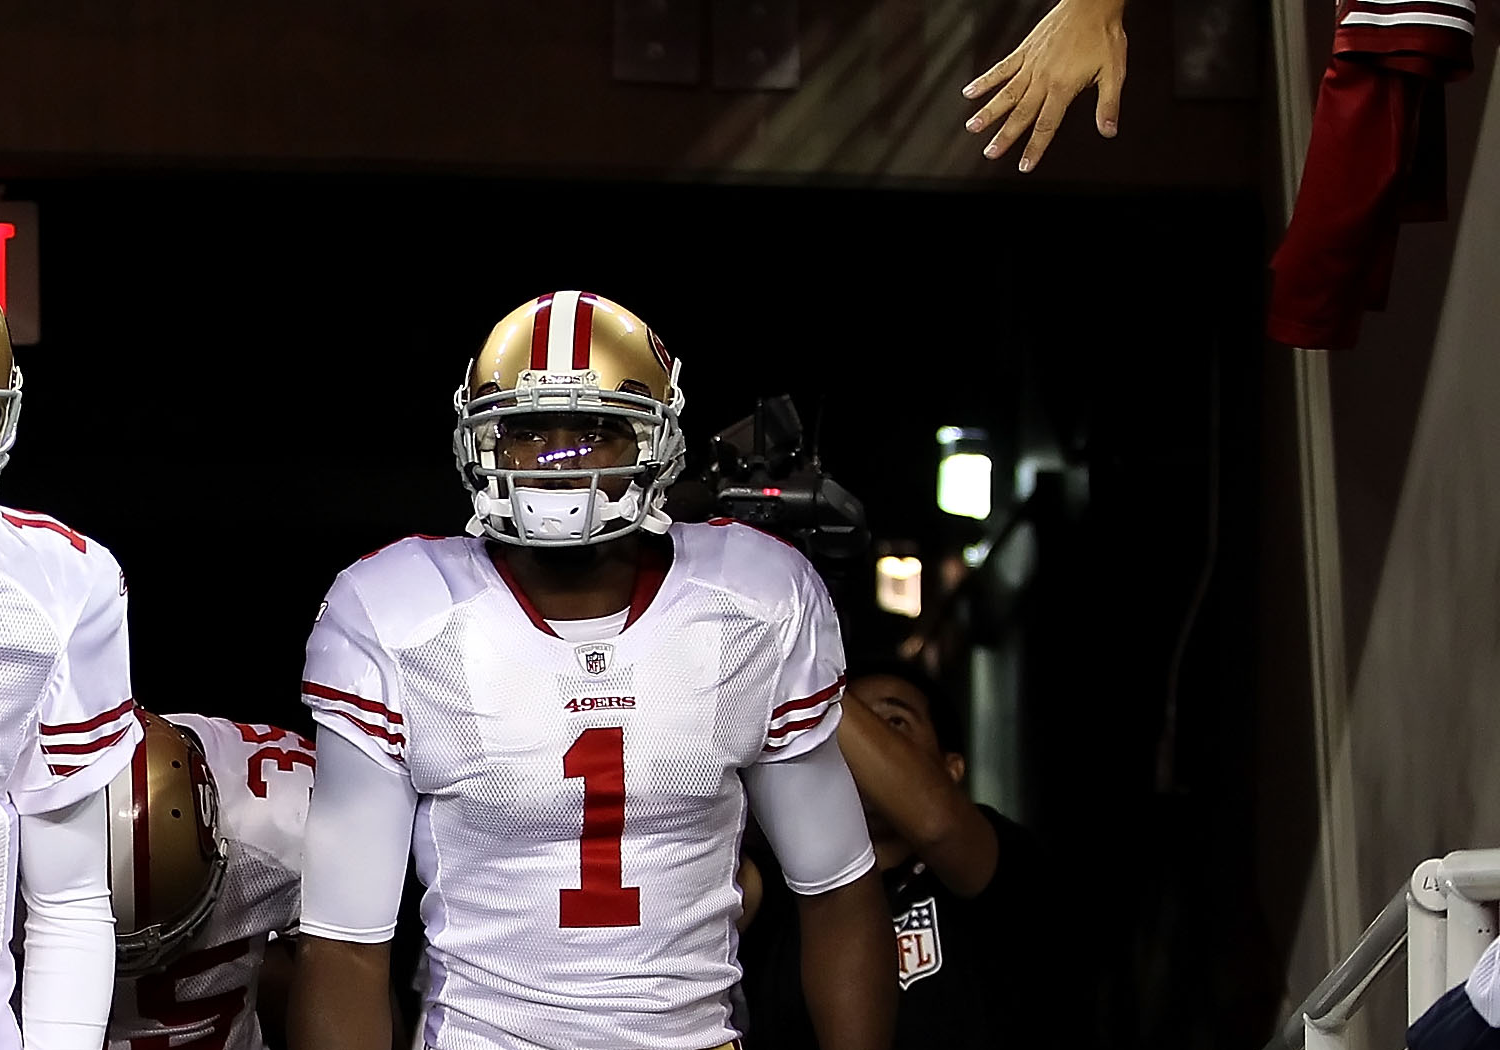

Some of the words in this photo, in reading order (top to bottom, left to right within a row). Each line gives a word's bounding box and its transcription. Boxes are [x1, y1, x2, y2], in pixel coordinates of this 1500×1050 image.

[563, 696, 636, 713] 49ERS
[559, 726, 641, 928] 1
[897, 933, 931, 974] FL
